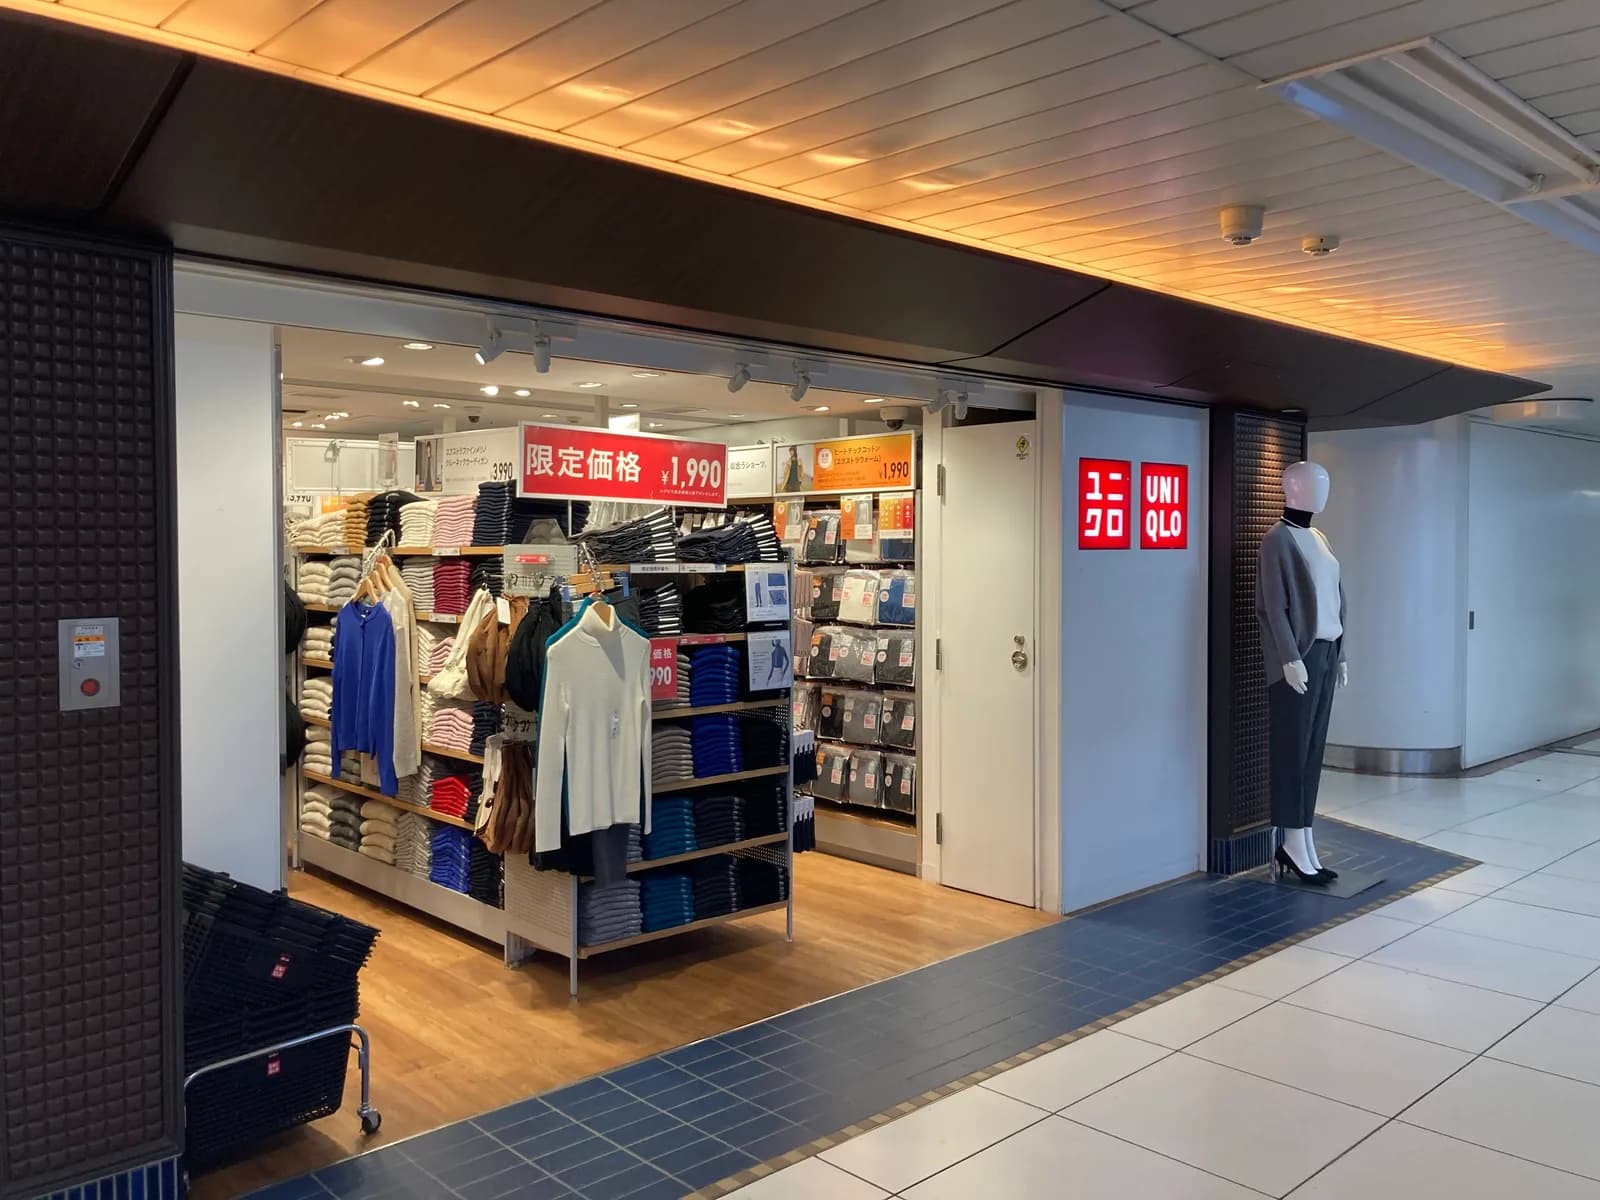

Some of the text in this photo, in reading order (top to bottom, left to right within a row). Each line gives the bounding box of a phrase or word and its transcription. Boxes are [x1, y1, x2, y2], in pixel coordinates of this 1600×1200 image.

[834, 445, 881, 456] ヒートテックコットン
[526, 443, 722, 489] 限定価格 ¥1,990
[1146, 475, 1179, 504] UNI
[1146, 509, 1182, 543] QLO
[653, 647, 673, 660] 価格
